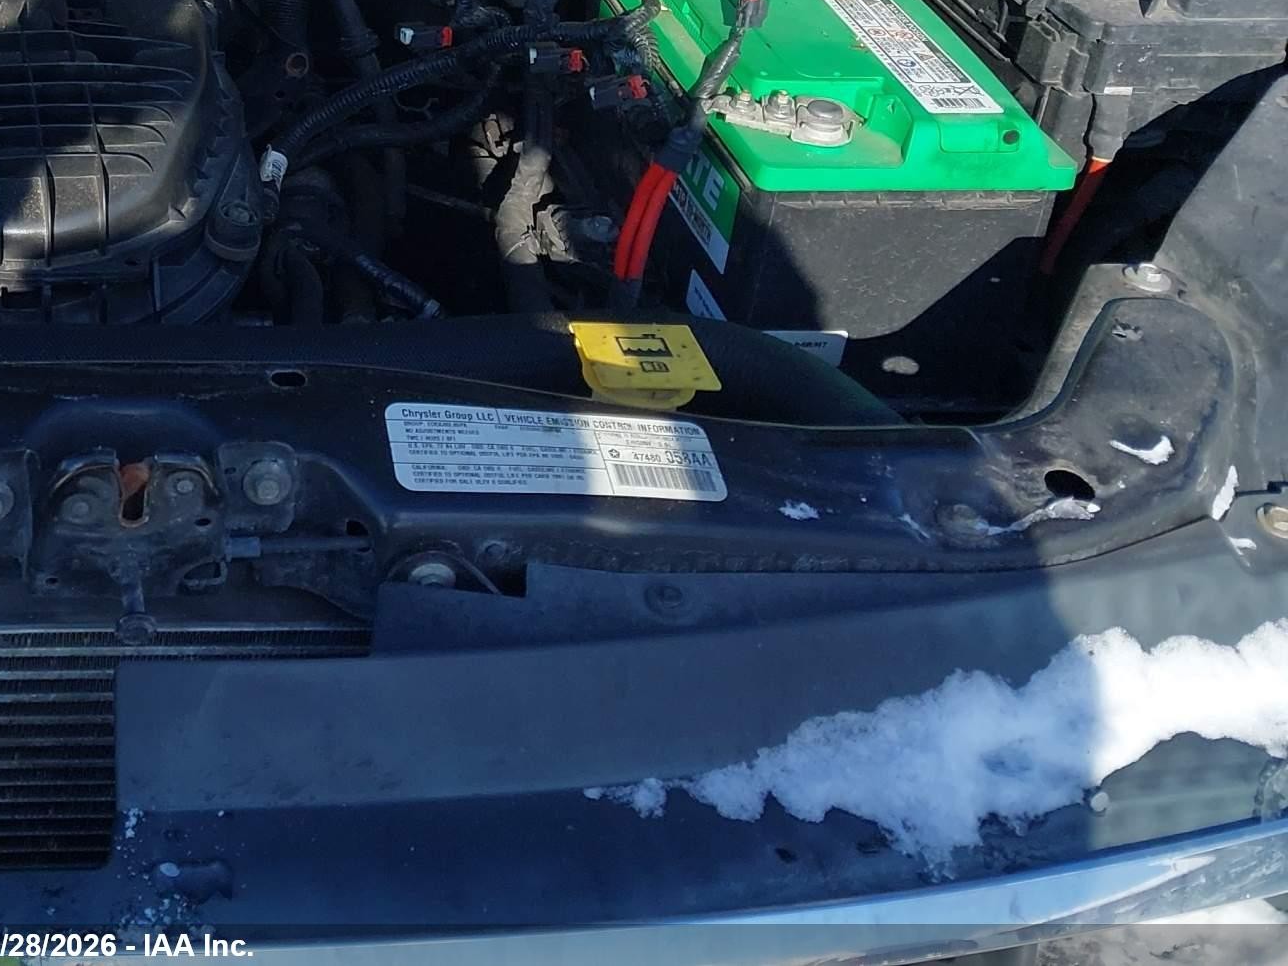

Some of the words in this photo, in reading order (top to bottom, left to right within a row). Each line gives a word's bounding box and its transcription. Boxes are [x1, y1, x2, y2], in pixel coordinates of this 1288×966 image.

[401, 408, 441, 421] Chrysler
[444, 409, 473, 421] Group
[475, 411, 495, 422] LLC
[503, 413, 544, 425] VEHICLE
[546, 417, 590, 428] EMISSION
[593, 420, 633, 431] CONTROL
[637, 423, 701, 435] INFORMATION
